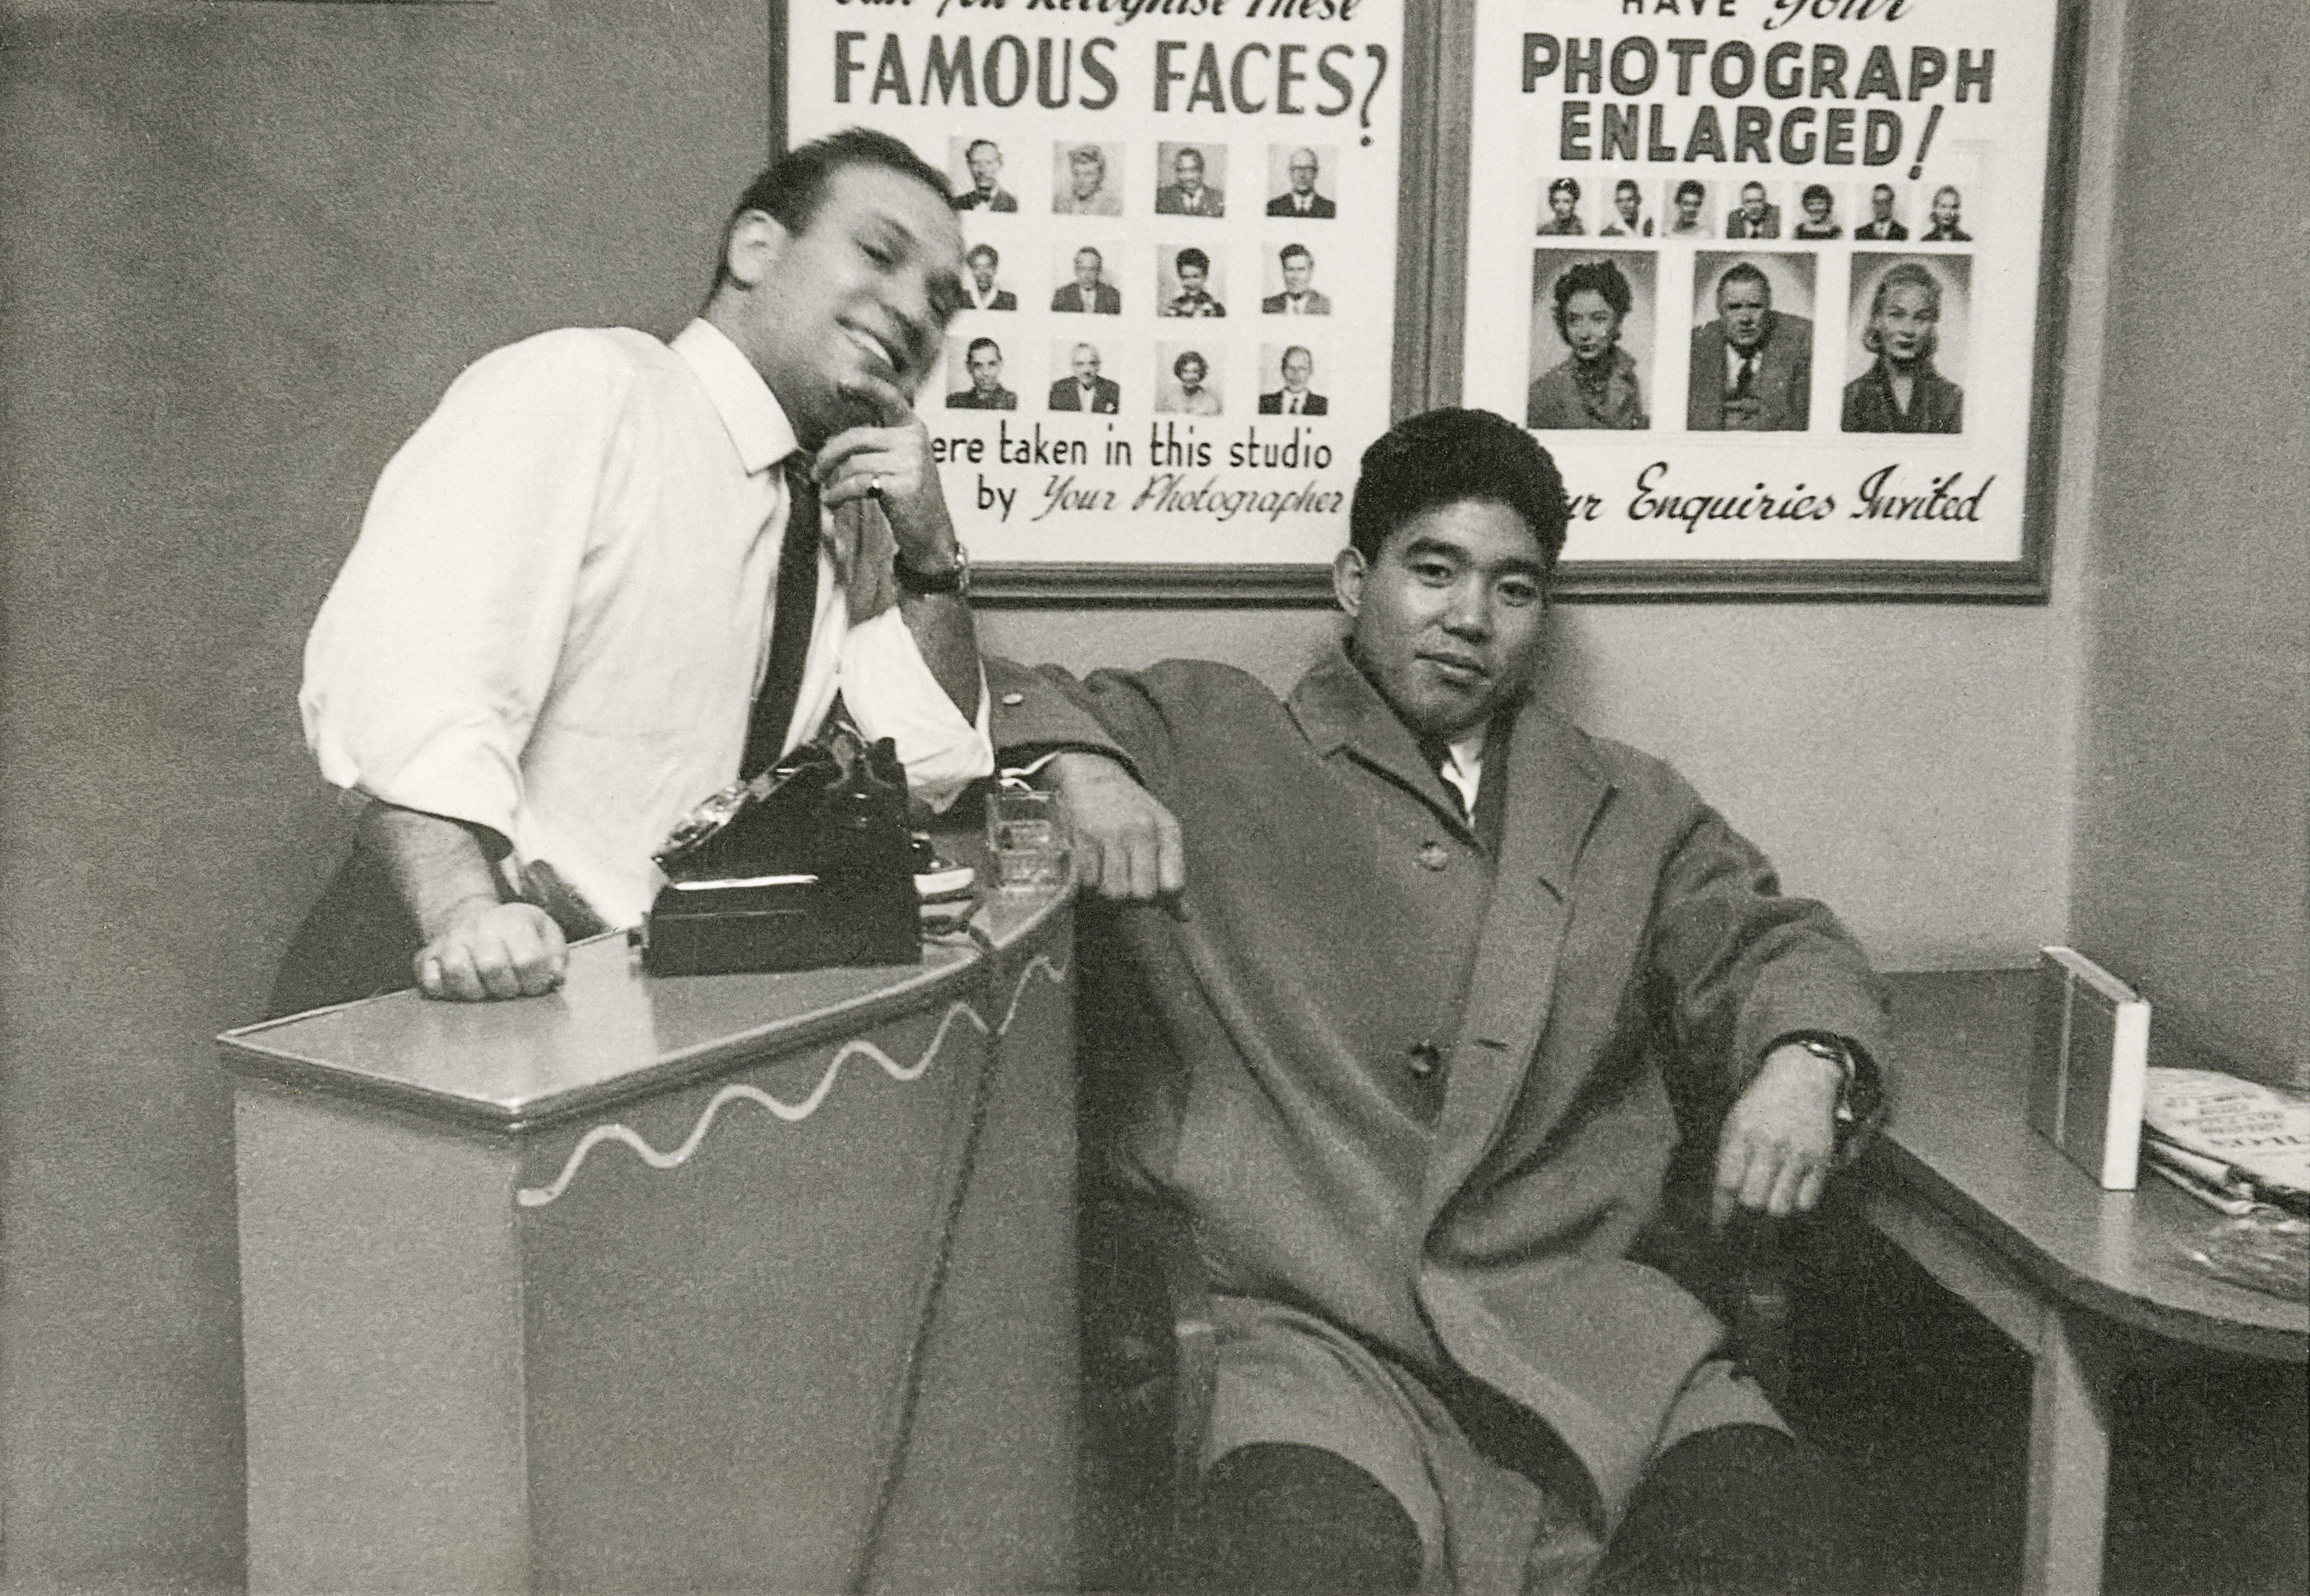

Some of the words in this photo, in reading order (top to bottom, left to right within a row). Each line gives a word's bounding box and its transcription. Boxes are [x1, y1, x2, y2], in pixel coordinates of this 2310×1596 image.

[833, 30, 1119, 110] FAMOUS
[1152, 40, 1388, 147] FACES?
[1521, 31, 1996, 103] PHOTOGRAPH
[1558, 100, 1945, 180] ENLARGED!
[931, 437, 985, 464] ere
[998, 418, 1088, 465] taken
[1105, 422, 1132, 466] in
[1149, 420, 1212, 468] this
[1229, 425, 1333, 469] studio
[976, 473, 1018, 523] by
[1030, 474, 1117, 522] Your
[1130, 473, 1345, 522] Photographer
[1626, 460, 1837, 534] Enquiries
[1848, 463, 1997, 523] Invited
